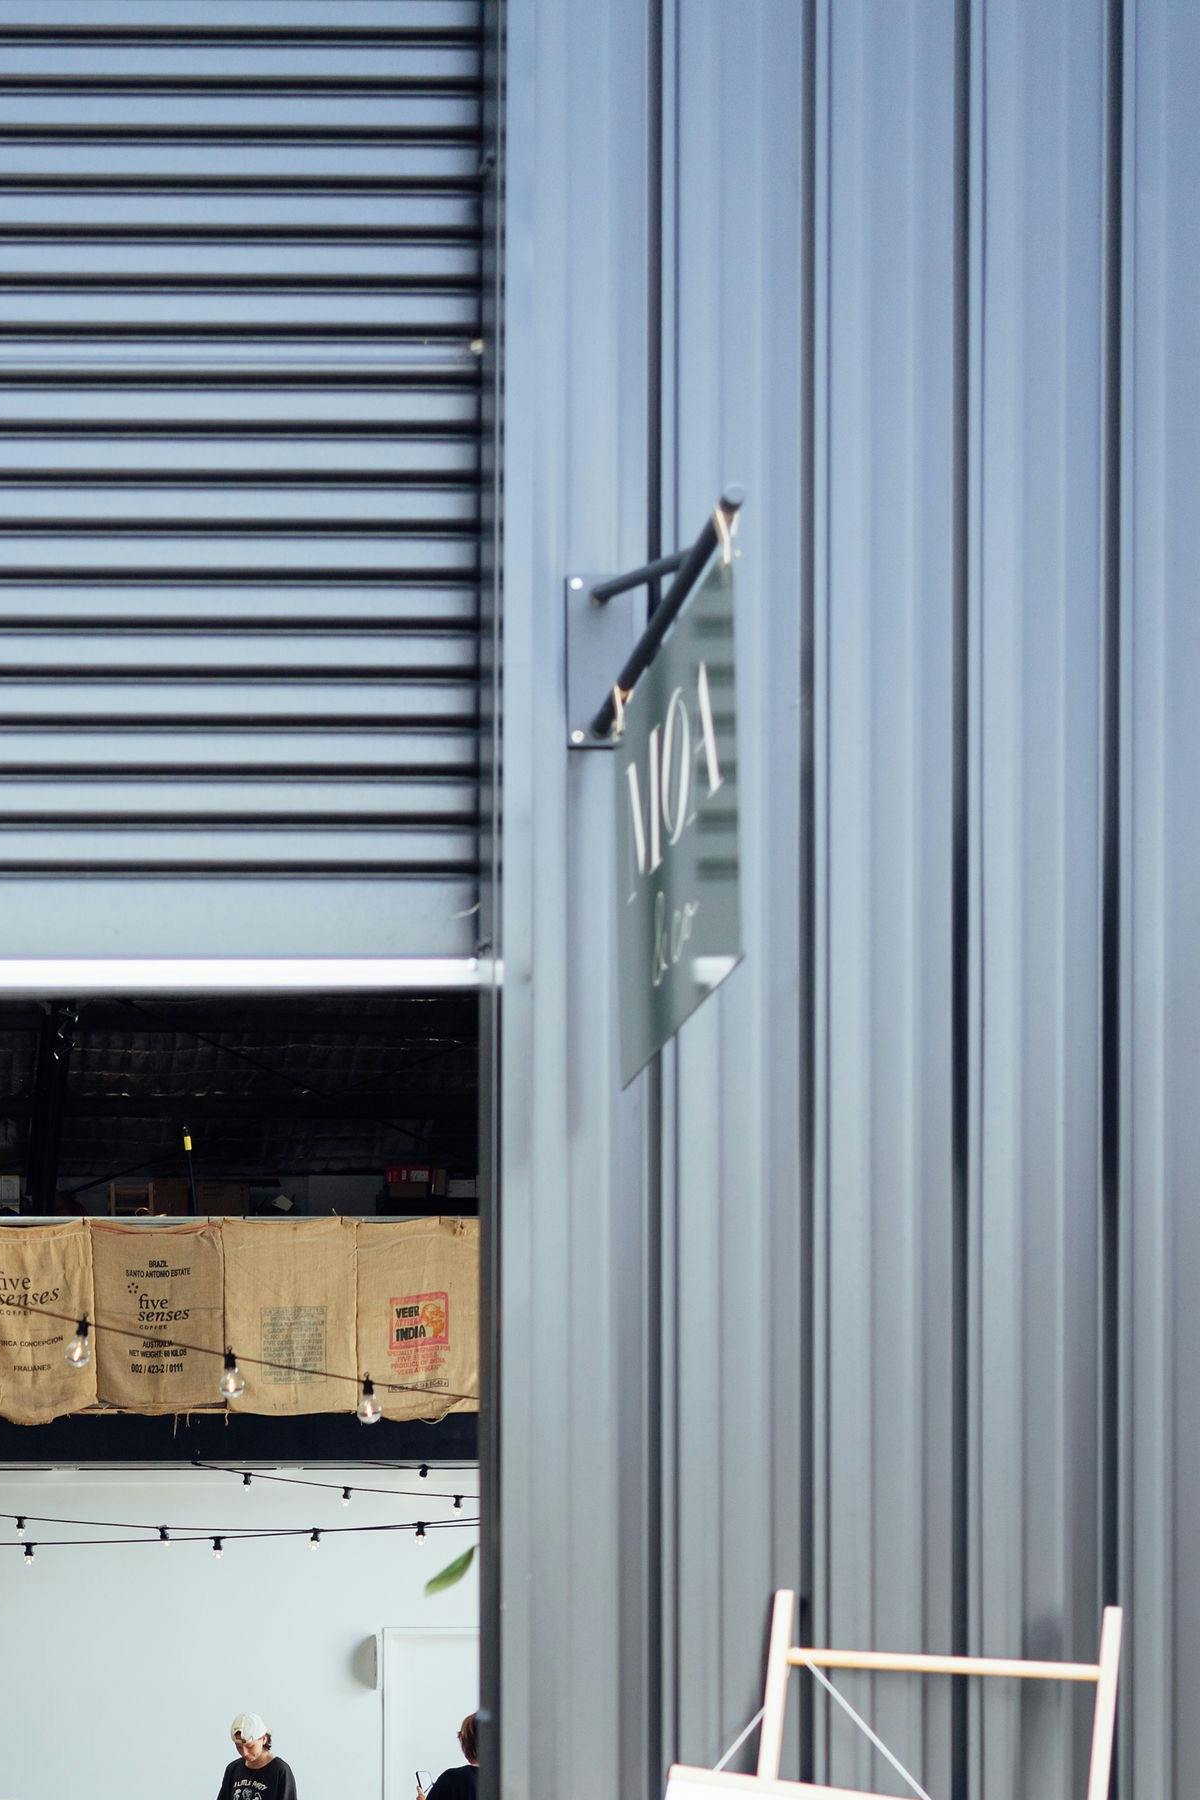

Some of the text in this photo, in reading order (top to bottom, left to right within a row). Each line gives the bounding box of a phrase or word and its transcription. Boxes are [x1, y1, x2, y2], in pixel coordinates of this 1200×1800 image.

[148, 1260, 169, 1268] BRAZIL
[125, 1267, 191, 1278] SANTO ANTONIO ESTATE
[139, 1293, 168, 1310] five
[138, 1308, 190, 1322] senses
[395, 1305, 420, 1319] VEER
[395, 1324, 426, 1342] INDIA
[19, 1335, 64, 1347] CONCEPCION
[142, 1339, 174, 1349] AUSTRALIA
[129, 1349, 140, 1357] NET
[171, 1349, 187, 1358] KILOS
[131, 1363, 143, 1374] 002
